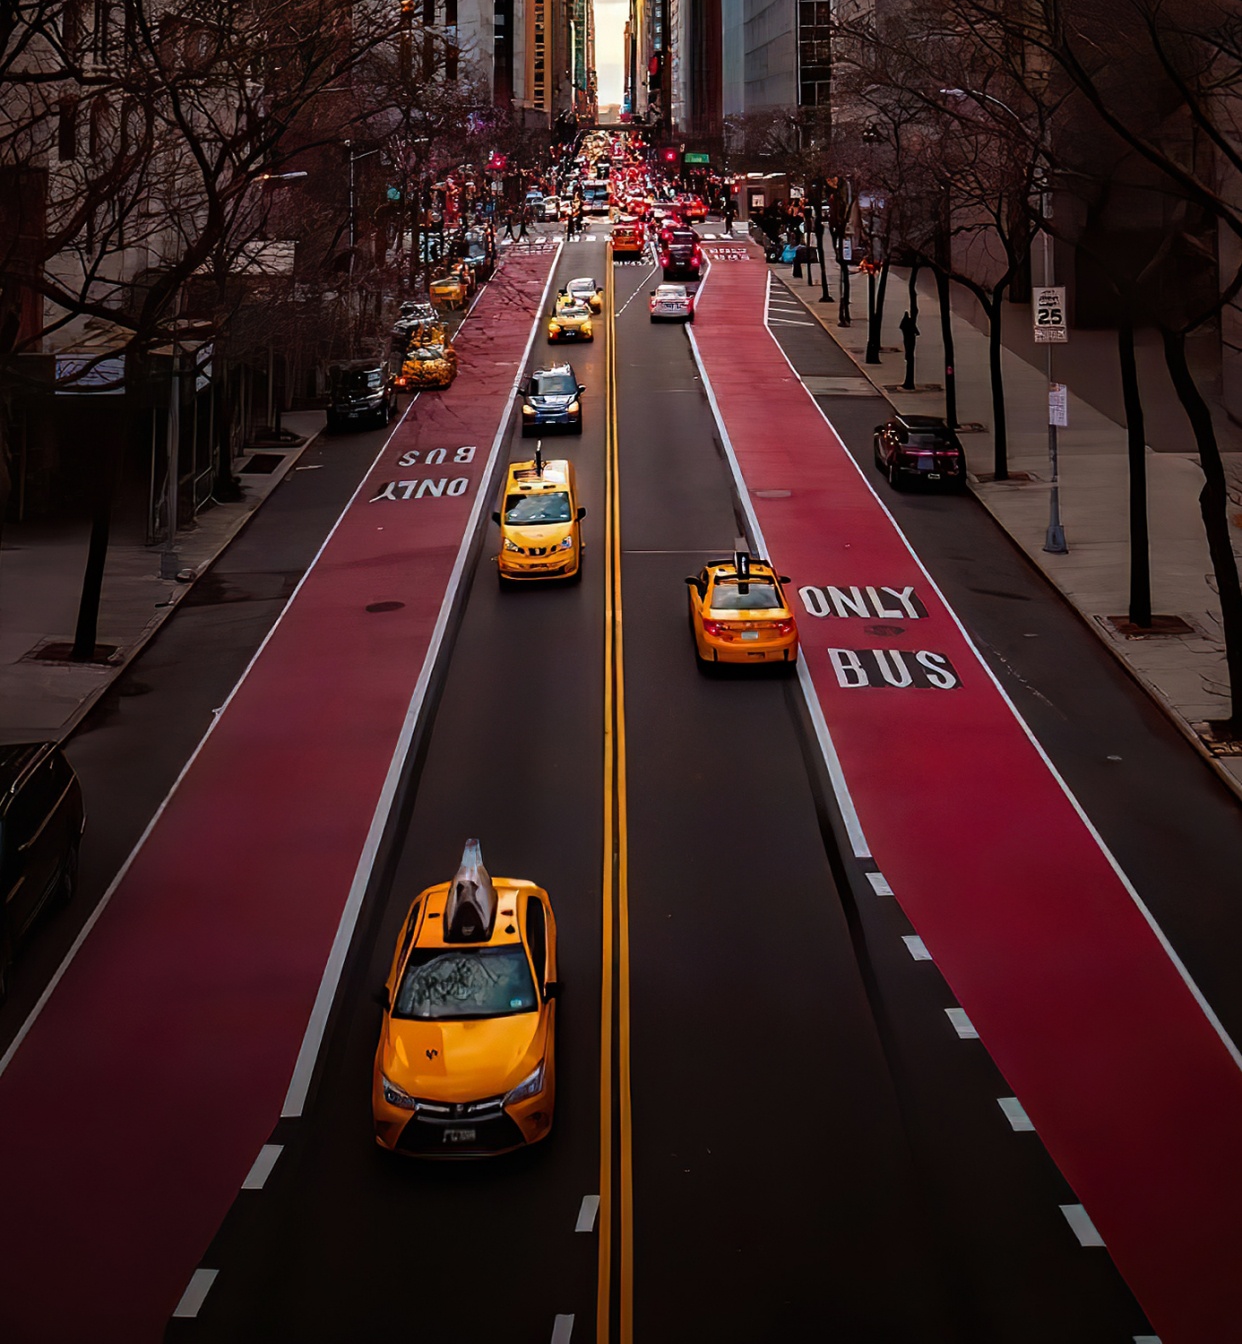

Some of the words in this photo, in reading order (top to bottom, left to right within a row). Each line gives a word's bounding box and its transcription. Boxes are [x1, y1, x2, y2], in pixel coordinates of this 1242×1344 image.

[1037, 308, 1063, 325] 25
[398, 446, 477, 467] BUS
[368, 477, 470, 504] ONLY
[798, 585, 920, 619] ONLY
[827, 647, 957, 690] BUS
